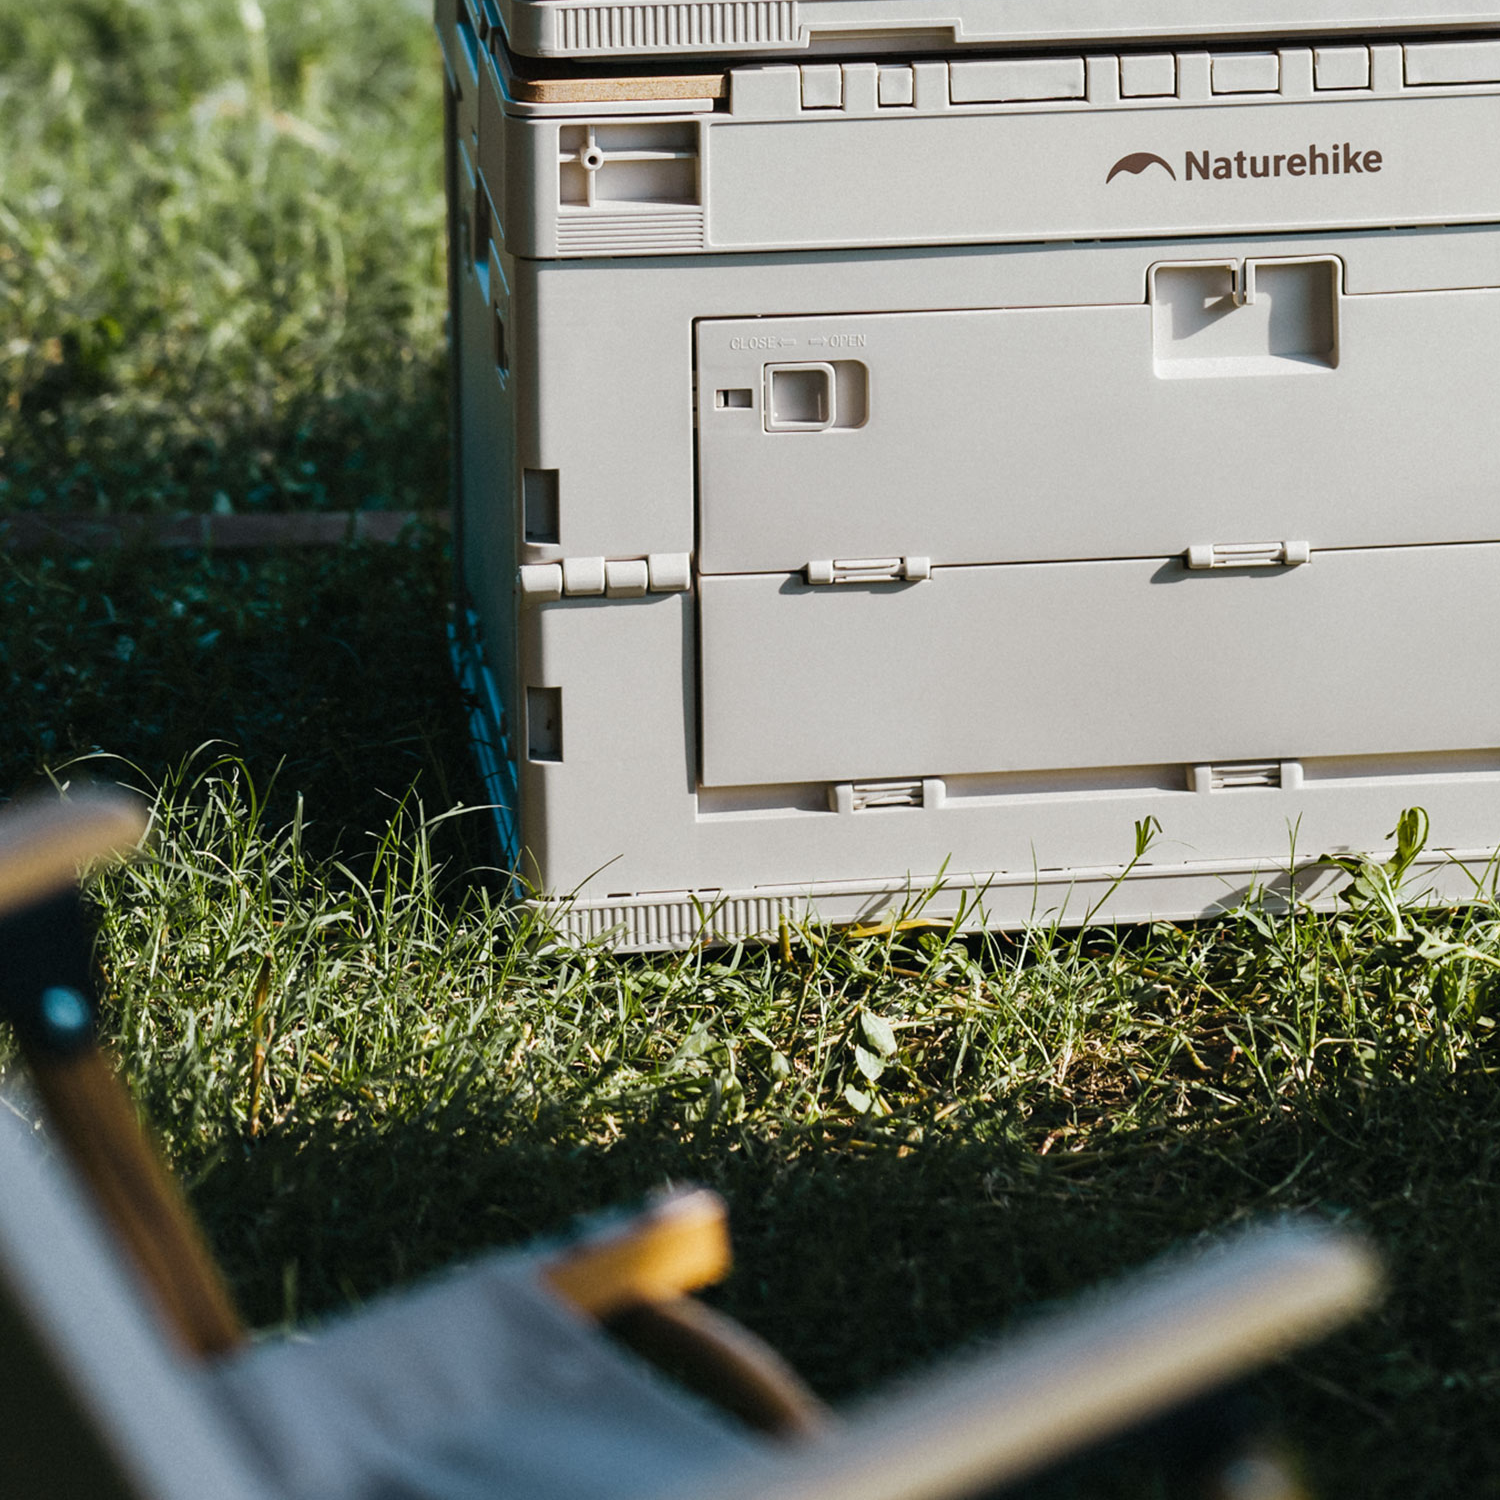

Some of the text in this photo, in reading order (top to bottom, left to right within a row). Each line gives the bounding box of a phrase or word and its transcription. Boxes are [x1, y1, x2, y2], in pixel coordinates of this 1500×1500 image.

[1184, 141, 1384, 182] Naturehike
[730, 334, 867, 350] CLOSE OPEN
